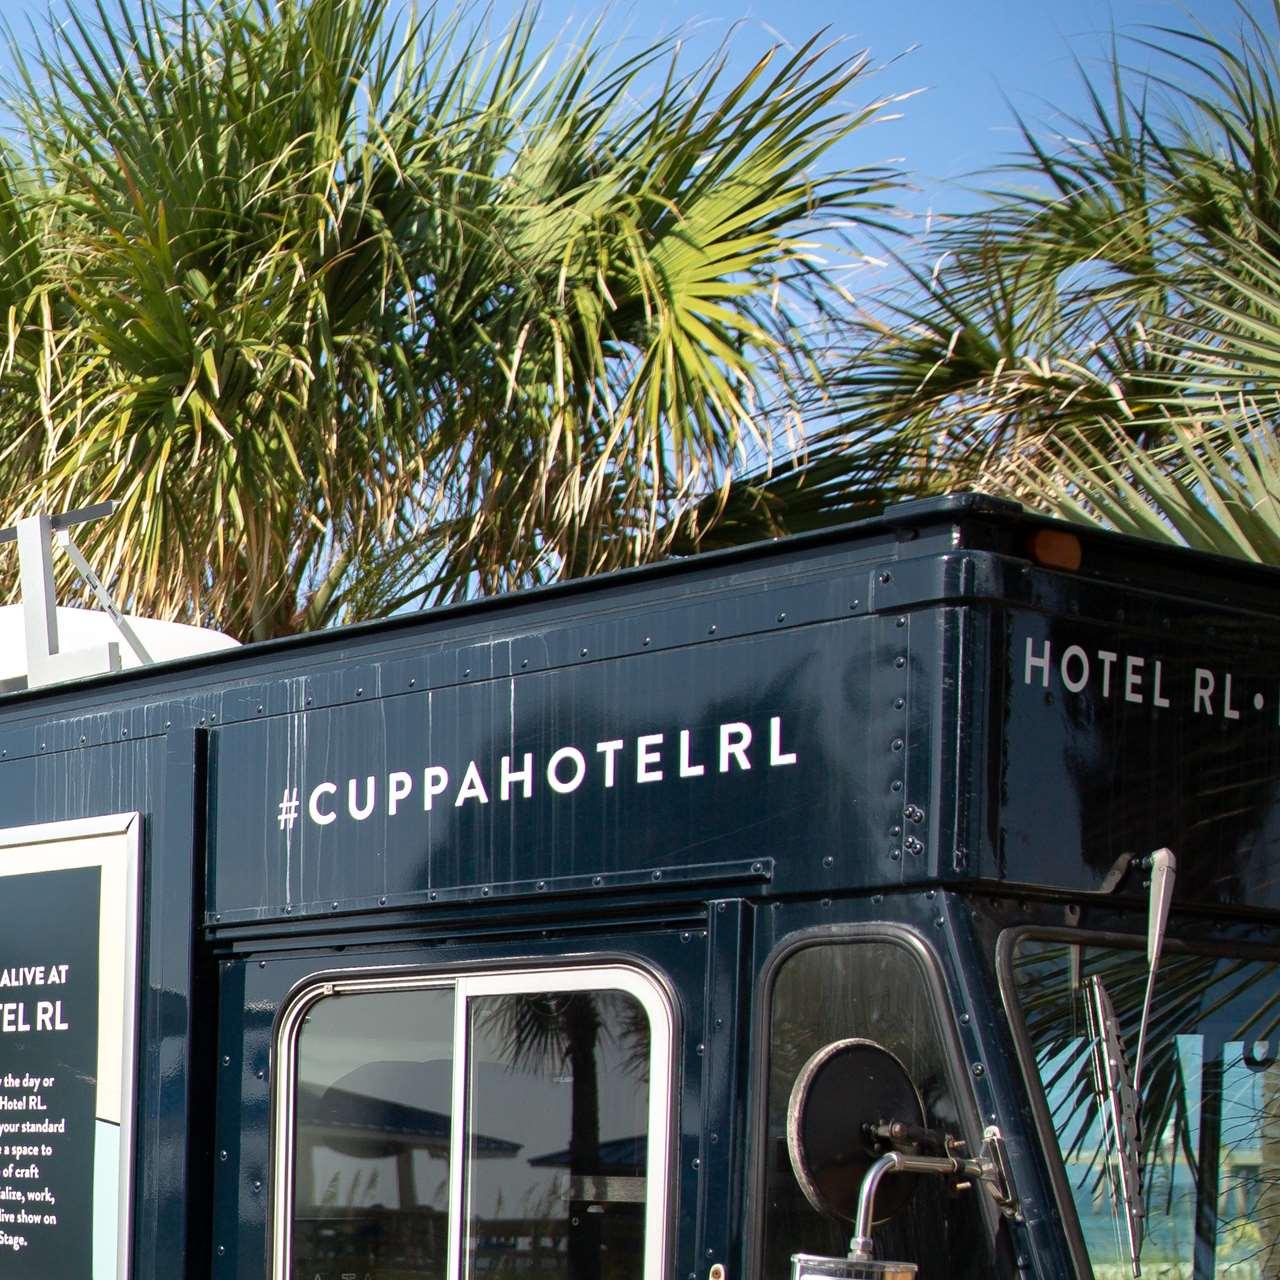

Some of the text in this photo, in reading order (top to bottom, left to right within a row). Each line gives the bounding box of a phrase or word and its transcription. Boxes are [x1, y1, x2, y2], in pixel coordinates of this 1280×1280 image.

[1024, 637, 1171, 708] HOTEL
[1193, 667, 1240, 720] RL
[277, 716, 797, 831] #CUPPAHOTELRL
[0, 965, 45, 987] ALIVE
[48, 964, 69, 985] AT
[36, 1000, 69, 1032] RL
[4, 1073, 20, 1088] the
[22, 1073, 40, 1092] day
[42, 1077, 55, 1087] or
[0, 1095, 26, 1110] Hotel
[28, 1095, 47, 1110] RL.
[21, 1118, 65, 1133] standard
[3, 1145, 10, 1155] a
[11, 1145, 39, 1160] space
[41, 1144, 53, 1156] to
[2, 1163, 14, 1178] of
[15, 1163, 39, 1179] craft
[27, 1187, 55, 1205] work,
[17, 1209, 41, 1224] show
[43, 1214, 56, 1225] on
